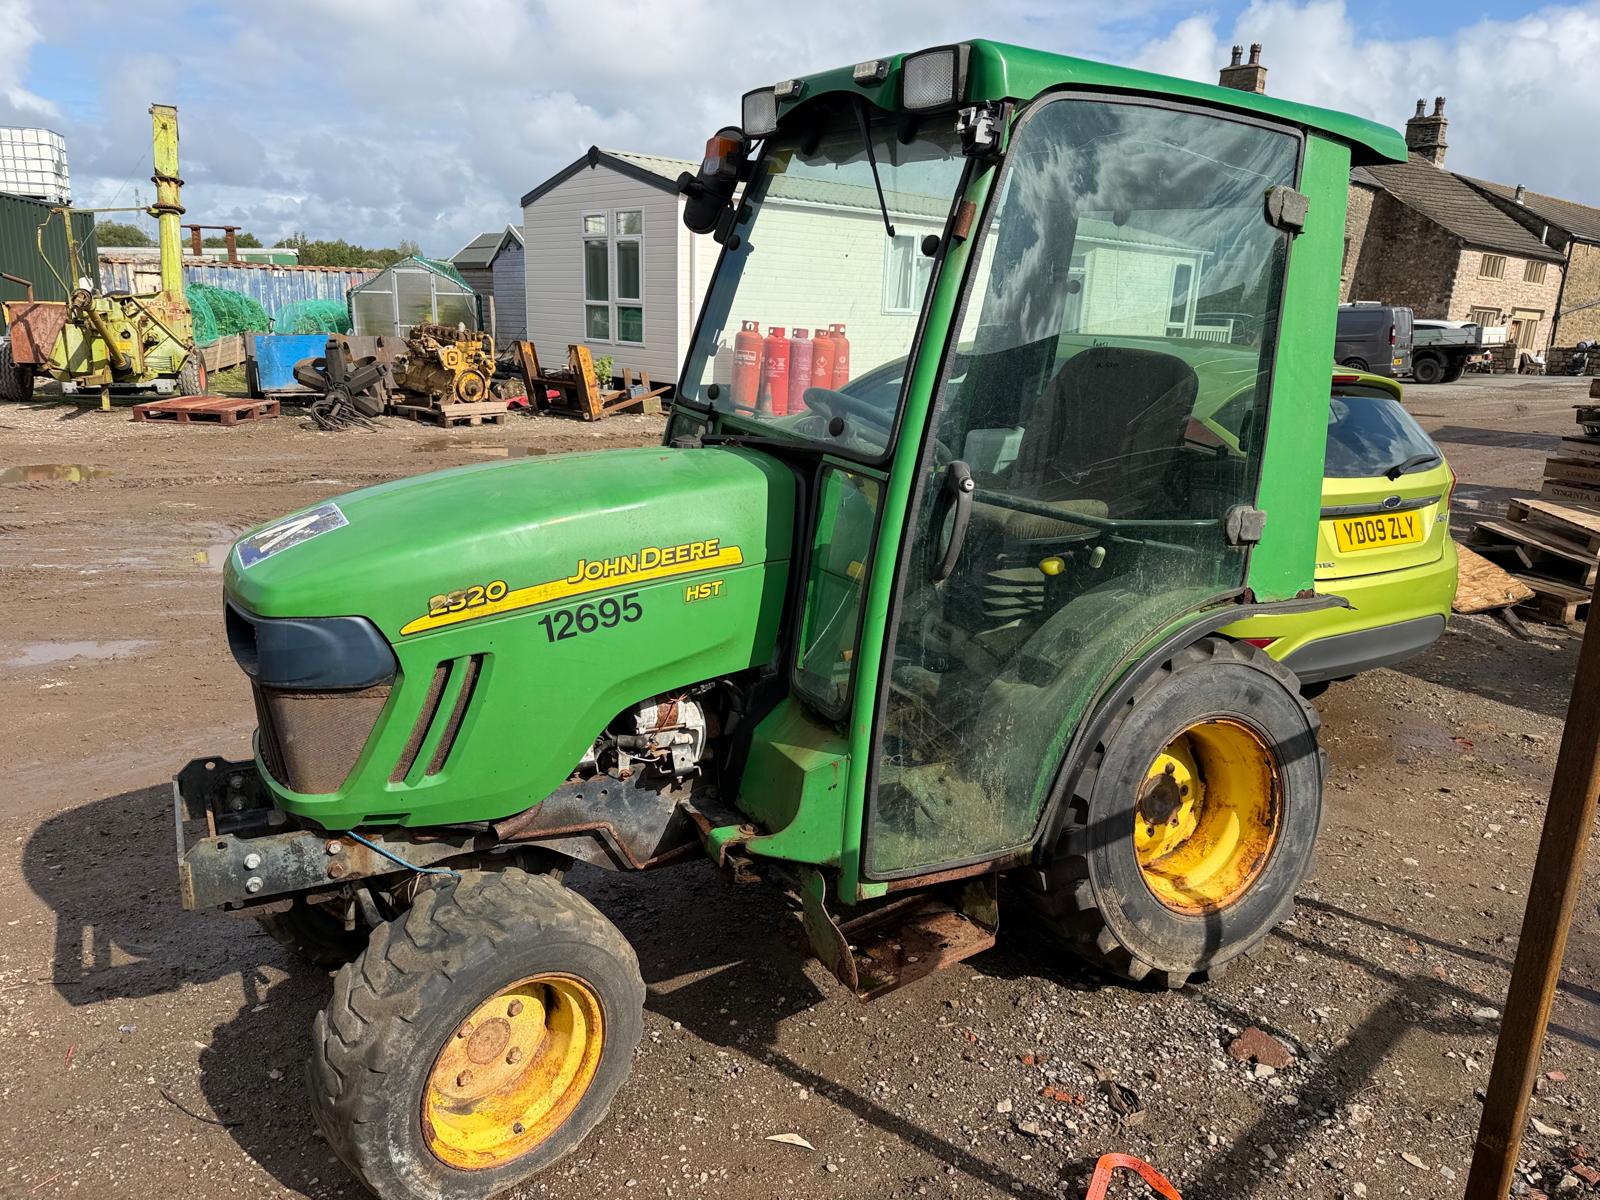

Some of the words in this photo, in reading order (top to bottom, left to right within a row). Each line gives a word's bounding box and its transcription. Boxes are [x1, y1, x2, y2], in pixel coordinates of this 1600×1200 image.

[1343, 519, 1386, 545] YD09
[1387, 515, 1415, 540] ZLY
[568, 555, 639, 584] JOHN
[640, 538, 720, 571] DEERE
[685, 580, 723, 603] HST
[538, 592, 643, 643] 12695
